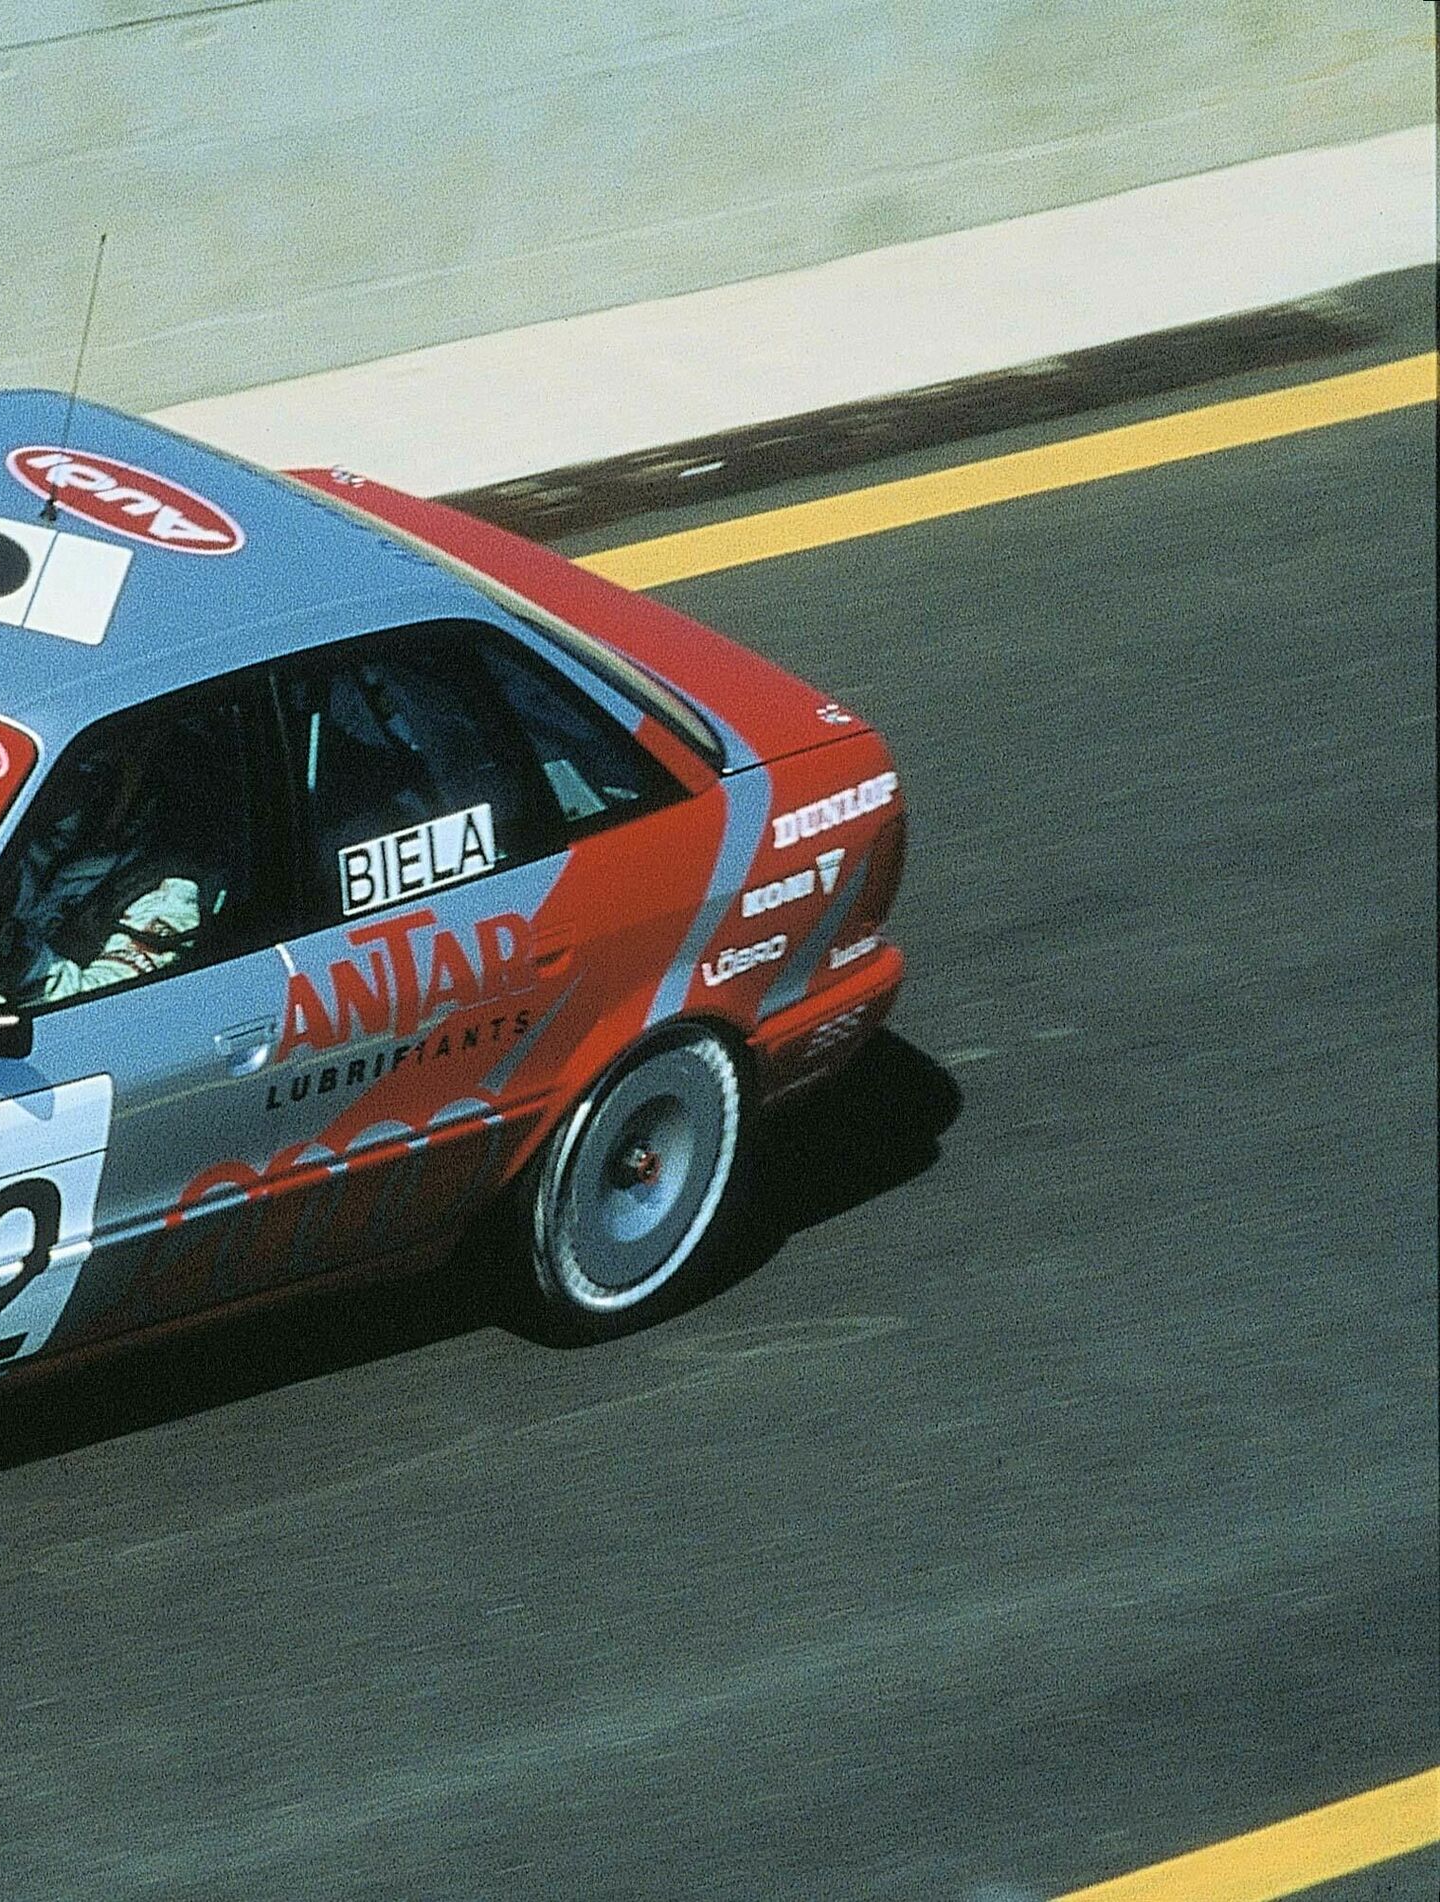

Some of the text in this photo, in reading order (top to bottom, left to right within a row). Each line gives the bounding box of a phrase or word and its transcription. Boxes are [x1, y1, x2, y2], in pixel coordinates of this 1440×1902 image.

[345, 812, 491, 911] BIELA
[273, 907, 536, 1064] ANTAR
[266, 1009, 531, 1111] LUBRIFIANTS
